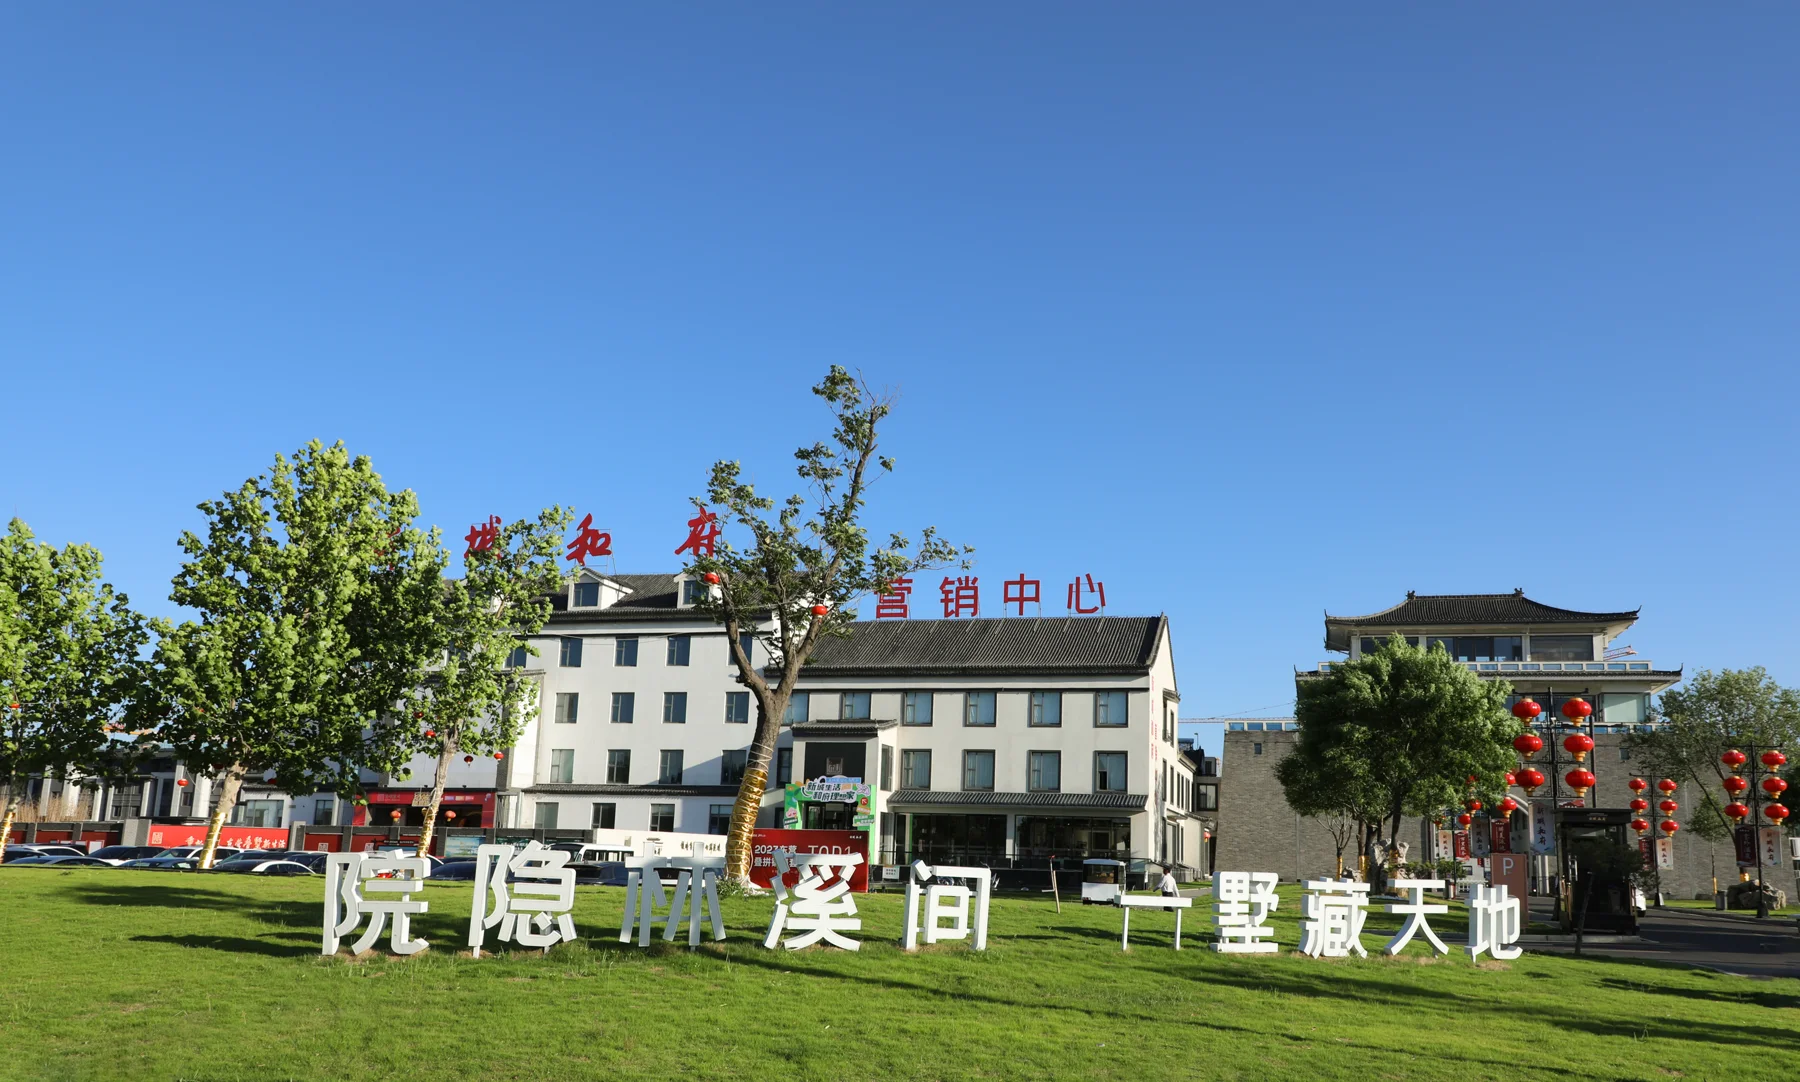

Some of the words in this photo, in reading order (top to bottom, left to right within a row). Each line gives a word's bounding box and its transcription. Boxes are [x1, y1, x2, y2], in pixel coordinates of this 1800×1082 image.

[874, 573, 1106, 619] 营销中心
[1503, 858, 1514, 875] P
[321, 841, 991, 957] 院隐林溪间
[1116, 871, 1523, 961] 一墅藏天地
